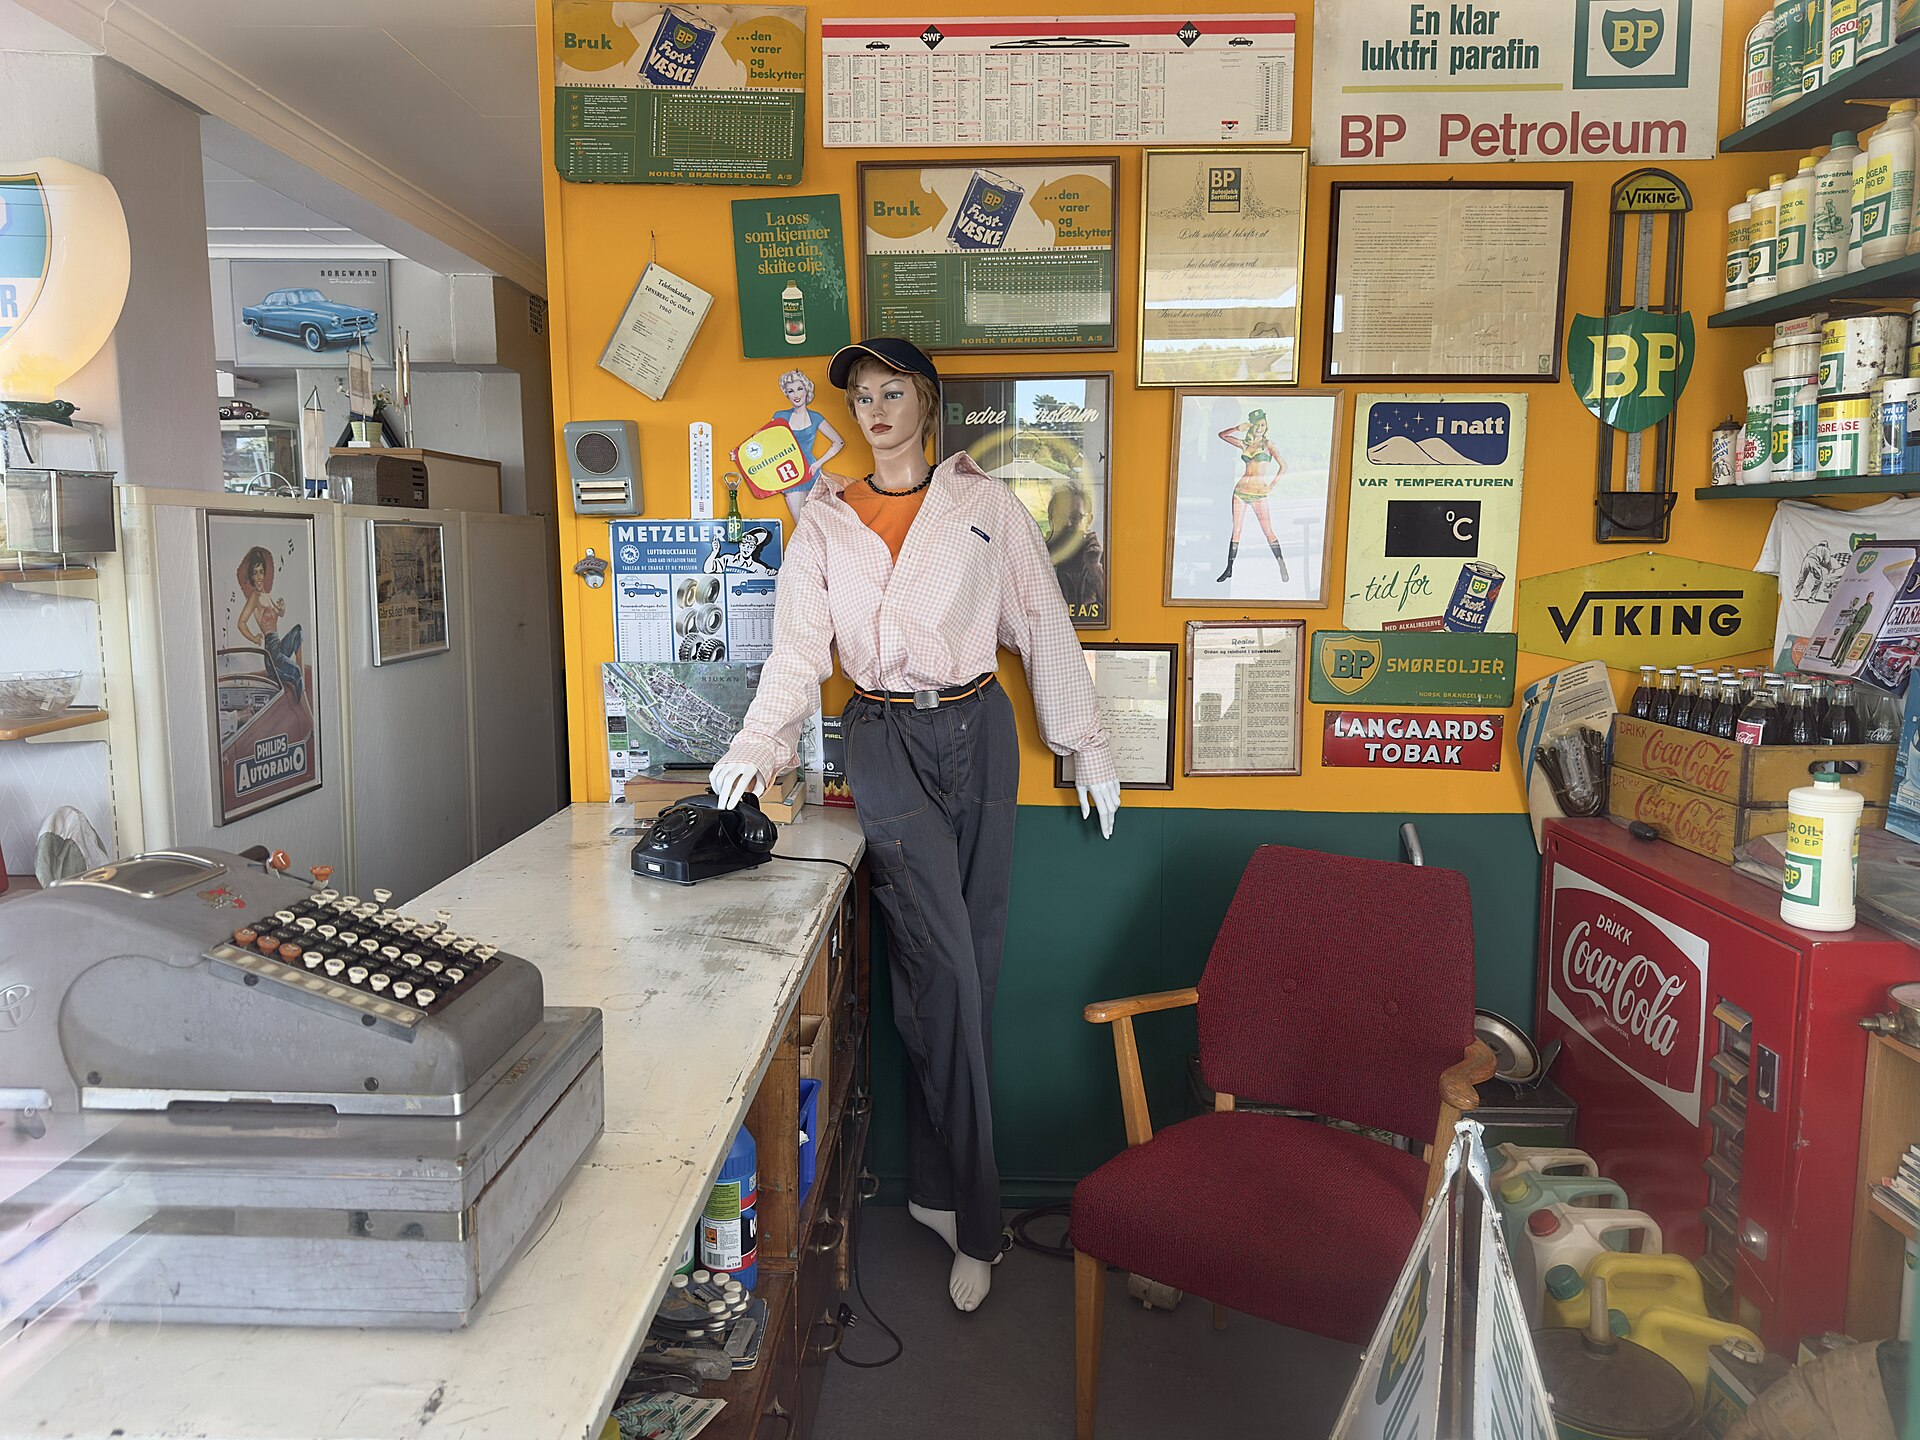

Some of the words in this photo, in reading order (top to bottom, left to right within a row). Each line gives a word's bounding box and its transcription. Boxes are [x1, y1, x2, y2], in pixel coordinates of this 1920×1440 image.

[1409, 3, 1441, 36] En
[1449, 1, 1500, 36] klar
[564, 32, 612, 50] Bruk
[675, 28, 694, 45] BP
[922, 30, 942, 42] SWF
[1178, 30, 1199, 42] SWF
[1610, 19, 1659, 53] BP
[750, 45, 782, 55] varer
[1361, 39, 1437, 72] luktfri
[1449, 38, 1540, 76] parafin
[1753, 53, 1764, 63] BP
[1831, 48, 1844, 65] BP
[649, 46, 695, 84] VÆSKE
[750, 58, 765, 69] og
[750, 68, 804, 82] beskytter
[1803, 75, 1815, 88] BP
[1340, 114, 1407, 159] BP
[1438, 110, 1687, 158] Petroleum
[649, 170, 683, 178] NORSK
[688, 171, 772, 180] BRÆNDSELOLJE
[1211, 170, 1236, 188] BP
[984, 193, 1001, 207] BP
[1624, 187, 1679, 209] VIKING
[873, 200, 922, 217] Bruk
[1058, 203, 1090, 213] varer
[765, 212, 786, 226] La
[787, 212, 810, 225] oss
[1058, 216, 1073, 227] og
[1863, 211, 1878, 227] BP
[745, 230, 775, 244] som
[776, 227, 830, 245] kjenner
[956, 213, 1003, 248] VÆSKE
[1058, 226, 1112, 240] beskytter
[759, 243, 795, 259] bilen
[796, 243, 823, 258] din,
[1815, 251, 1836, 266] BP
[758, 259, 796, 275] skifte
[798, 257, 827, 275] olje.
[1727, 264, 1741, 278] BP
[658, 278, 692, 303] Telefonkatalog
[659, 304, 672, 315] 1960
[961, 337, 996, 345] NORSK
[1000, 336, 1083, 344] BRÆNDSELOLJE
[1584, 332, 1685, 400] BP
[945, 402, 1007, 426] Bedre
[1436, 416, 1445, 435] i
[1450, 416, 1505, 435] natt
[1771, 431, 1793, 453] BP
[747, 443, 797, 476] Continental
[1819, 449, 1832, 461] BP
[778, 462, 798, 482] R
[1358, 478, 1388, 487] VAR
[1394, 478, 1514, 487] TEMPERATUREN
[618, 525, 726, 543] METZELER
[727, 522, 741, 534] BP
[1858, 554, 1877, 568] BP
[1365, 571, 1399, 602] tid
[1398, 563, 1433, 612] for
[1472, 581, 1487, 591] BP
[1078, 603, 1099, 618] A/S
[1451, 605, 1485, 625] VÆSKE
[1547, 590, 1744, 644] VIKING
[1886, 605, 1906, 627] CAR
[1384, 624, 1398, 632] MED
[1398, 620, 1442, 630] ALKALIRESERVE
[1331, 649, 1375, 680] BP
[1386, 657, 1505, 675] SMØREOLJER
[1334, 717, 1495, 741] LANGAARDS
[1619, 720, 1648, 739] DRIKK
[255, 735, 288, 760] PHILIPS
[1364, 743, 1463, 765] TOBAK
[238, 745, 305, 791] AUTORADIO
[1641, 729, 1735, 794] Coca-Cola
[1634, 783, 1727, 854] Coca-Cola
[1797, 822, 1820, 837] OIL
[1804, 839, 1819, 847] EP
[1785, 868, 1799, 884] BP
[1595, 914, 1633, 946] DRIKK
[1562, 921, 1687, 1057] Coca-Cola
